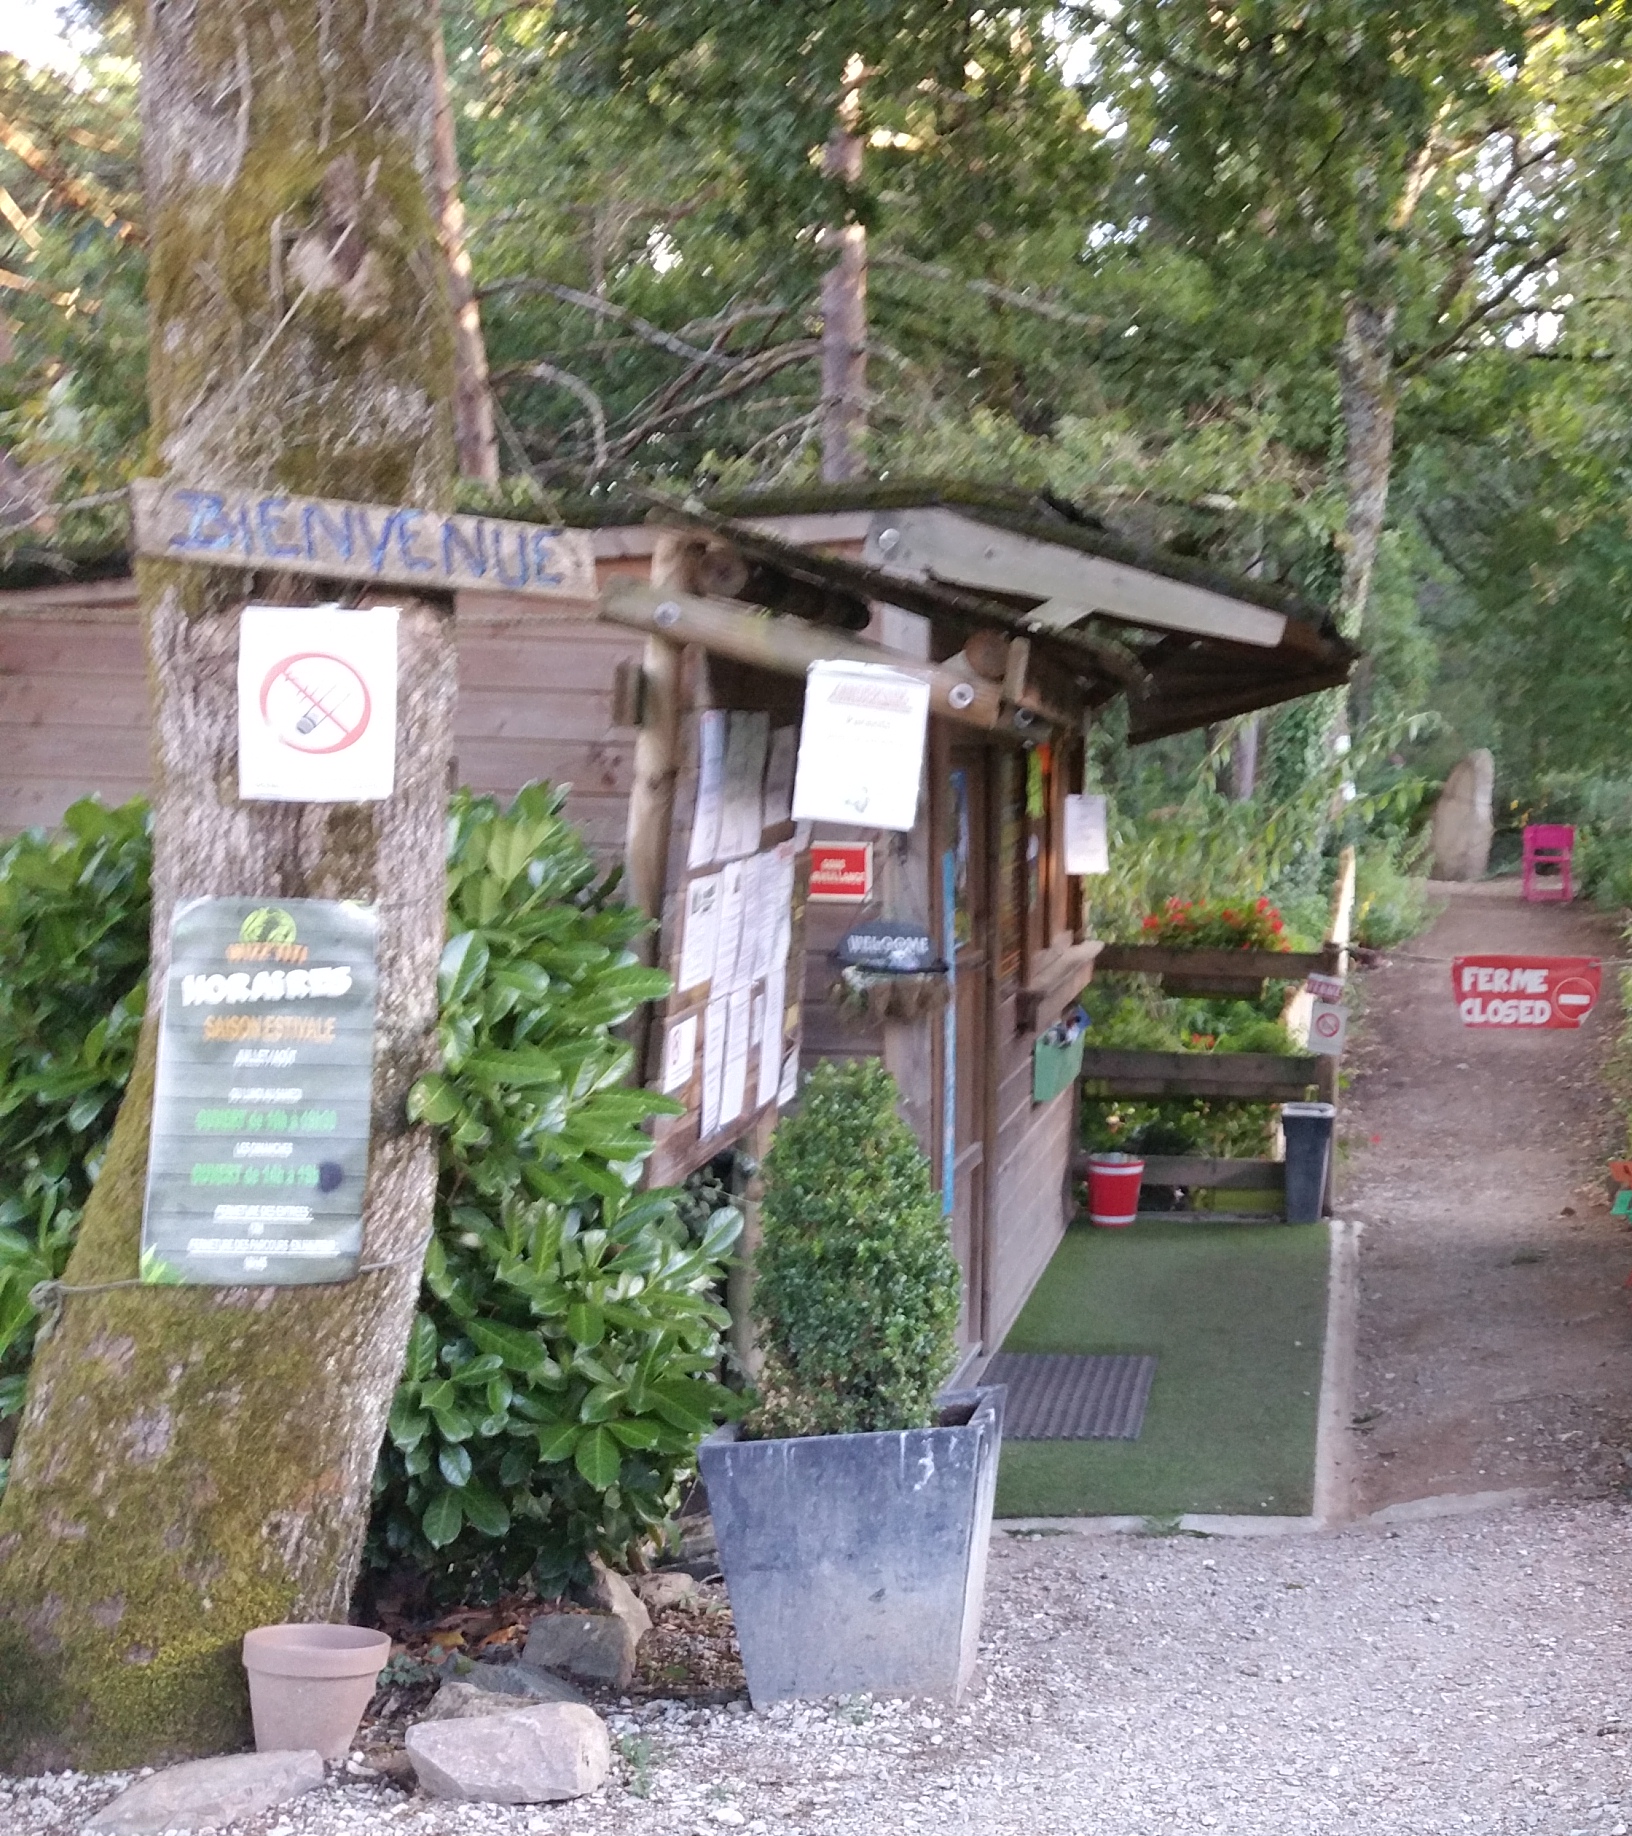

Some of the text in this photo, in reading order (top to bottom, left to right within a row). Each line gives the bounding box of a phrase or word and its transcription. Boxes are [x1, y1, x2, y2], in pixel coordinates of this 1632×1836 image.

[168, 488, 564, 589] BIENVENUE
[846, 934, 930, 956] WELCOME
[181, 966, 353, 1007] HORAIRES
[1461, 966, 1549, 994] FERME
[1459, 997, 1552, 1024] CLOSED
[203, 1014, 337, 1043] SAISON ESTIVALE
